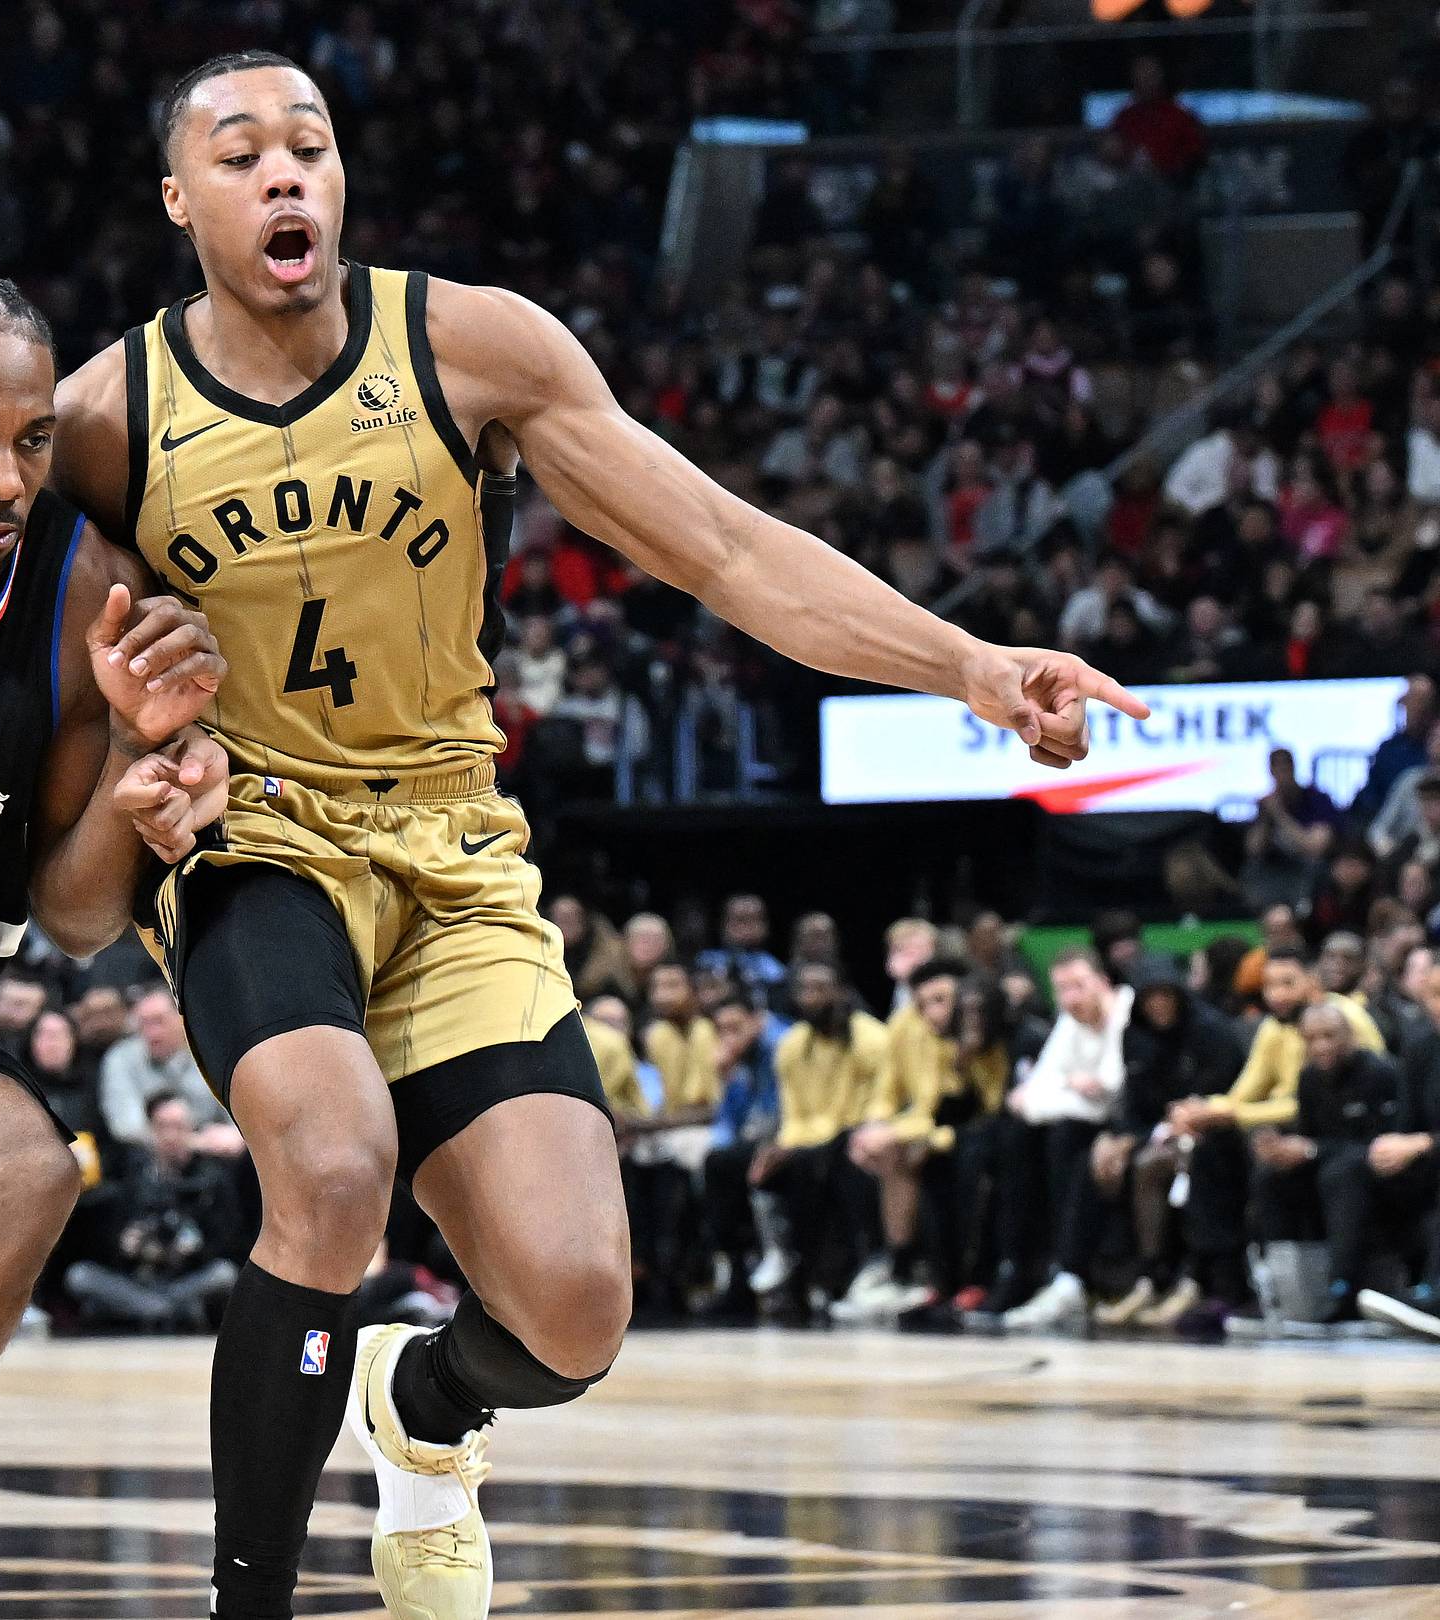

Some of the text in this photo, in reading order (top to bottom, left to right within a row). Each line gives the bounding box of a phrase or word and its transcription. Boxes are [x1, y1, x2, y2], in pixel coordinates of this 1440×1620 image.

[351, 407, 417, 431] Sun Life
[162, 475, 449, 607] ORONTO
[283, 599, 357, 708] 4
[962, 698, 1273, 751] STCHEK
